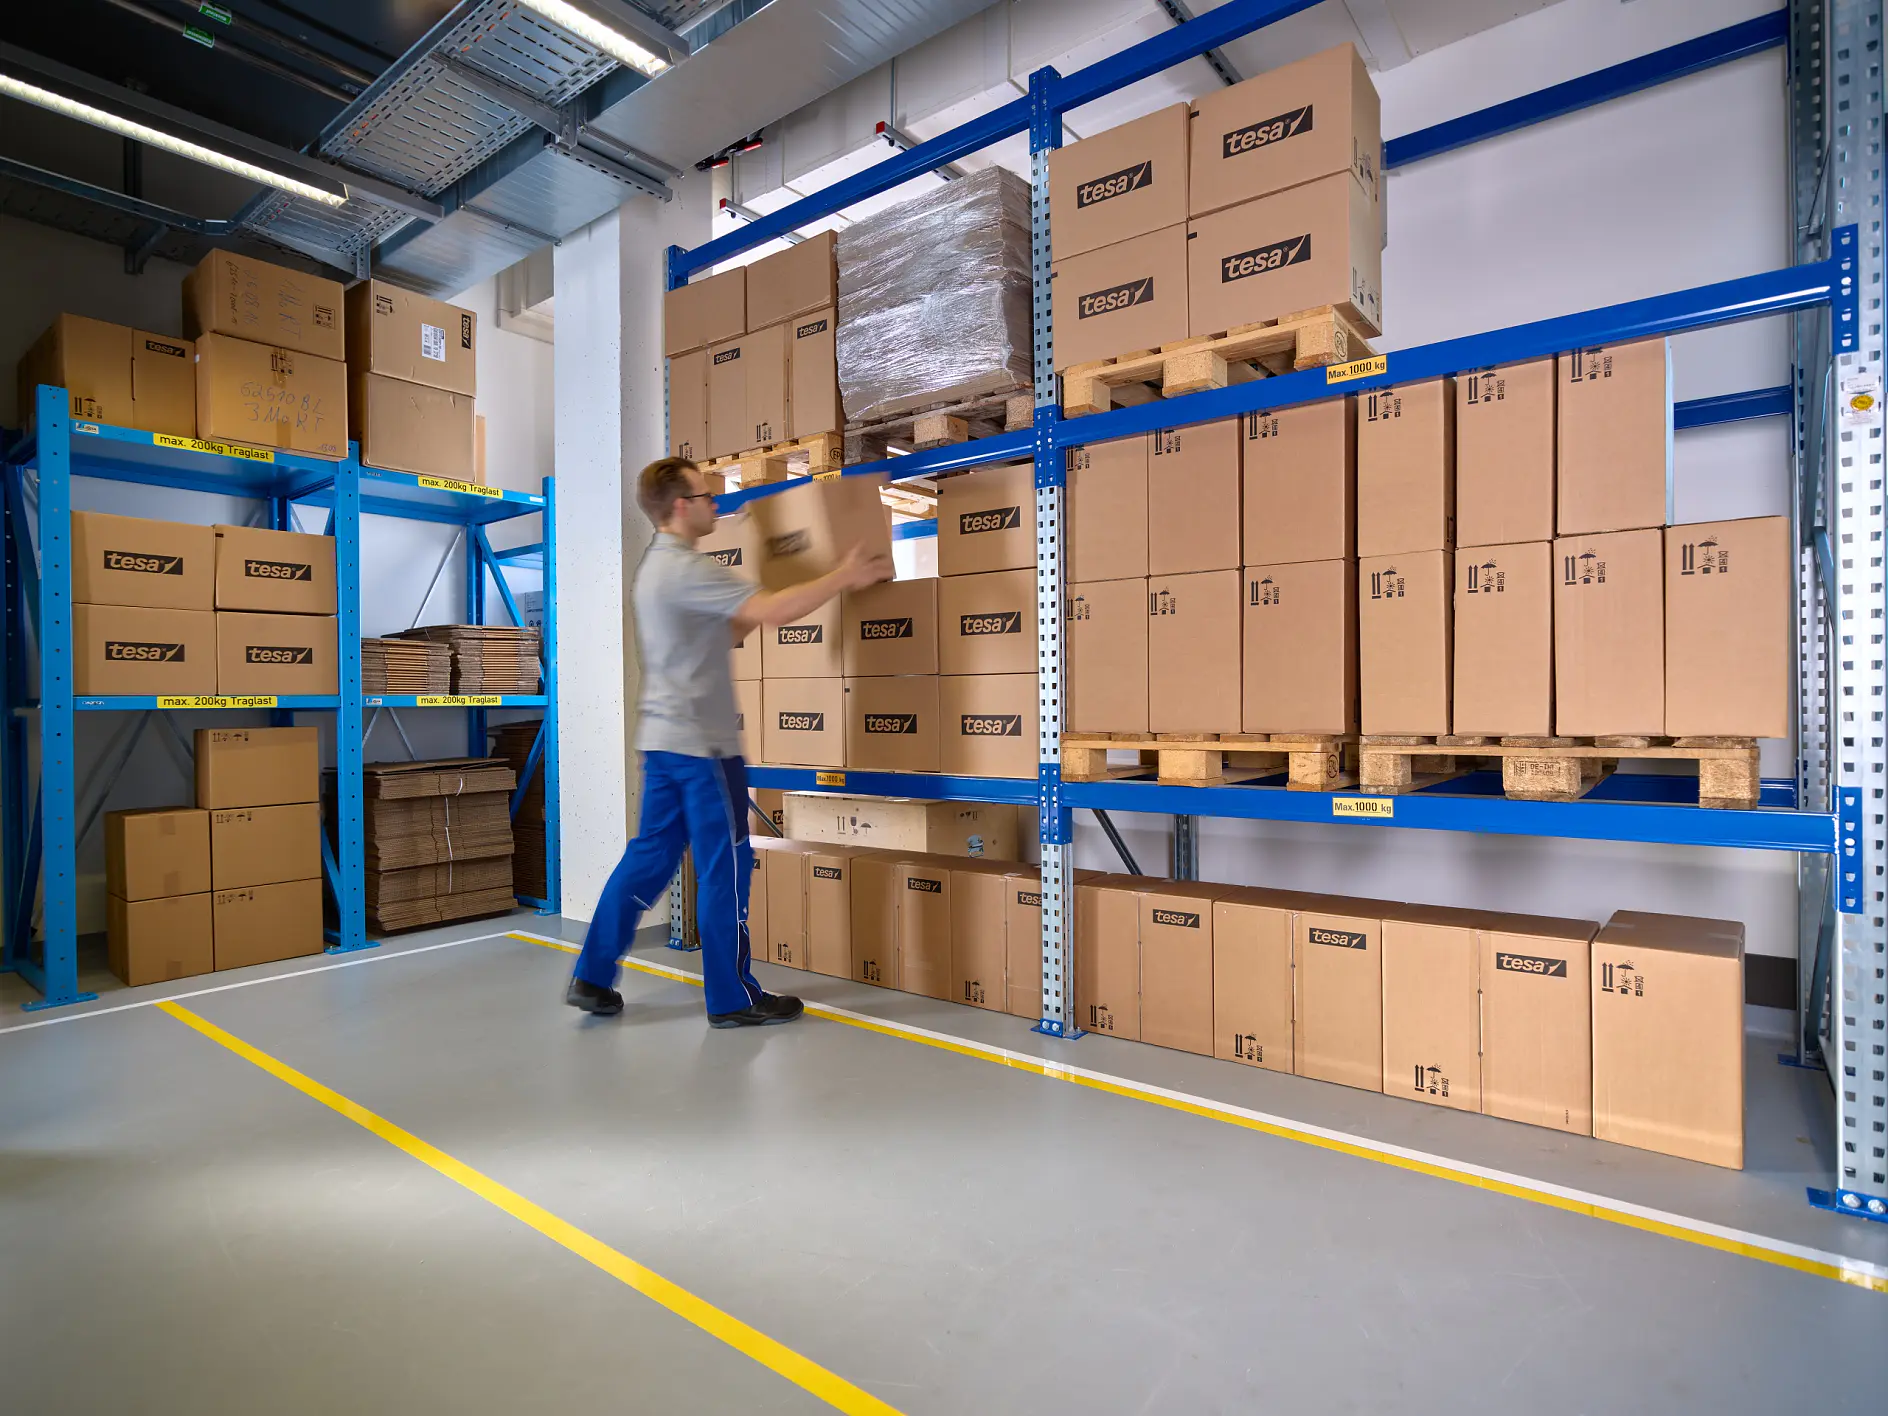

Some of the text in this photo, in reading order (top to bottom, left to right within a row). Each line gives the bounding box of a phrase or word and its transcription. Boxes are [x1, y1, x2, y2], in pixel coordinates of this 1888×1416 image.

[1226, 121, 1285, 154] tesa
[1079, 175, 1129, 205] tesa
[1224, 248, 1283, 278] tesa
[1081, 290, 1130, 316] tesa
[462, 317, 470, 339] tesa
[798, 323, 818, 337] tesa
[148, 341, 174, 355] tesa
[714, 351, 733, 364] tesa
[1374, 360, 1386, 375] kg
[160, 435, 270, 460] max. 200kg Traglast
[422, 478, 499, 496] max. 200kg Traglast
[962, 513, 1001, 533] tesa
[107, 552, 160, 572] tesa
[248, 562, 291, 579] tesa
[863, 621, 897, 638] tesa
[963, 615, 1003, 635] tesa
[780, 627, 809, 643] tesa
[108, 643, 161, 661] tesa
[249, 648, 292, 663] tesa
[163, 696, 272, 708] max. 200kg Traglast
[442, 696, 466, 705] 200kg
[469, 696, 498, 705] Traglast
[781, 713, 810, 730] tesa
[867, 715, 900, 732] tesa
[963, 717, 1003, 735] tesa
[1381, 803, 1392, 814] kg
[815, 867, 834, 879] tesa
[910, 878, 931, 891] tesa
[1155, 911, 1185, 925] tesa
[1312, 929, 1349, 946] tesa
[1500, 955, 1545, 974] tesa
